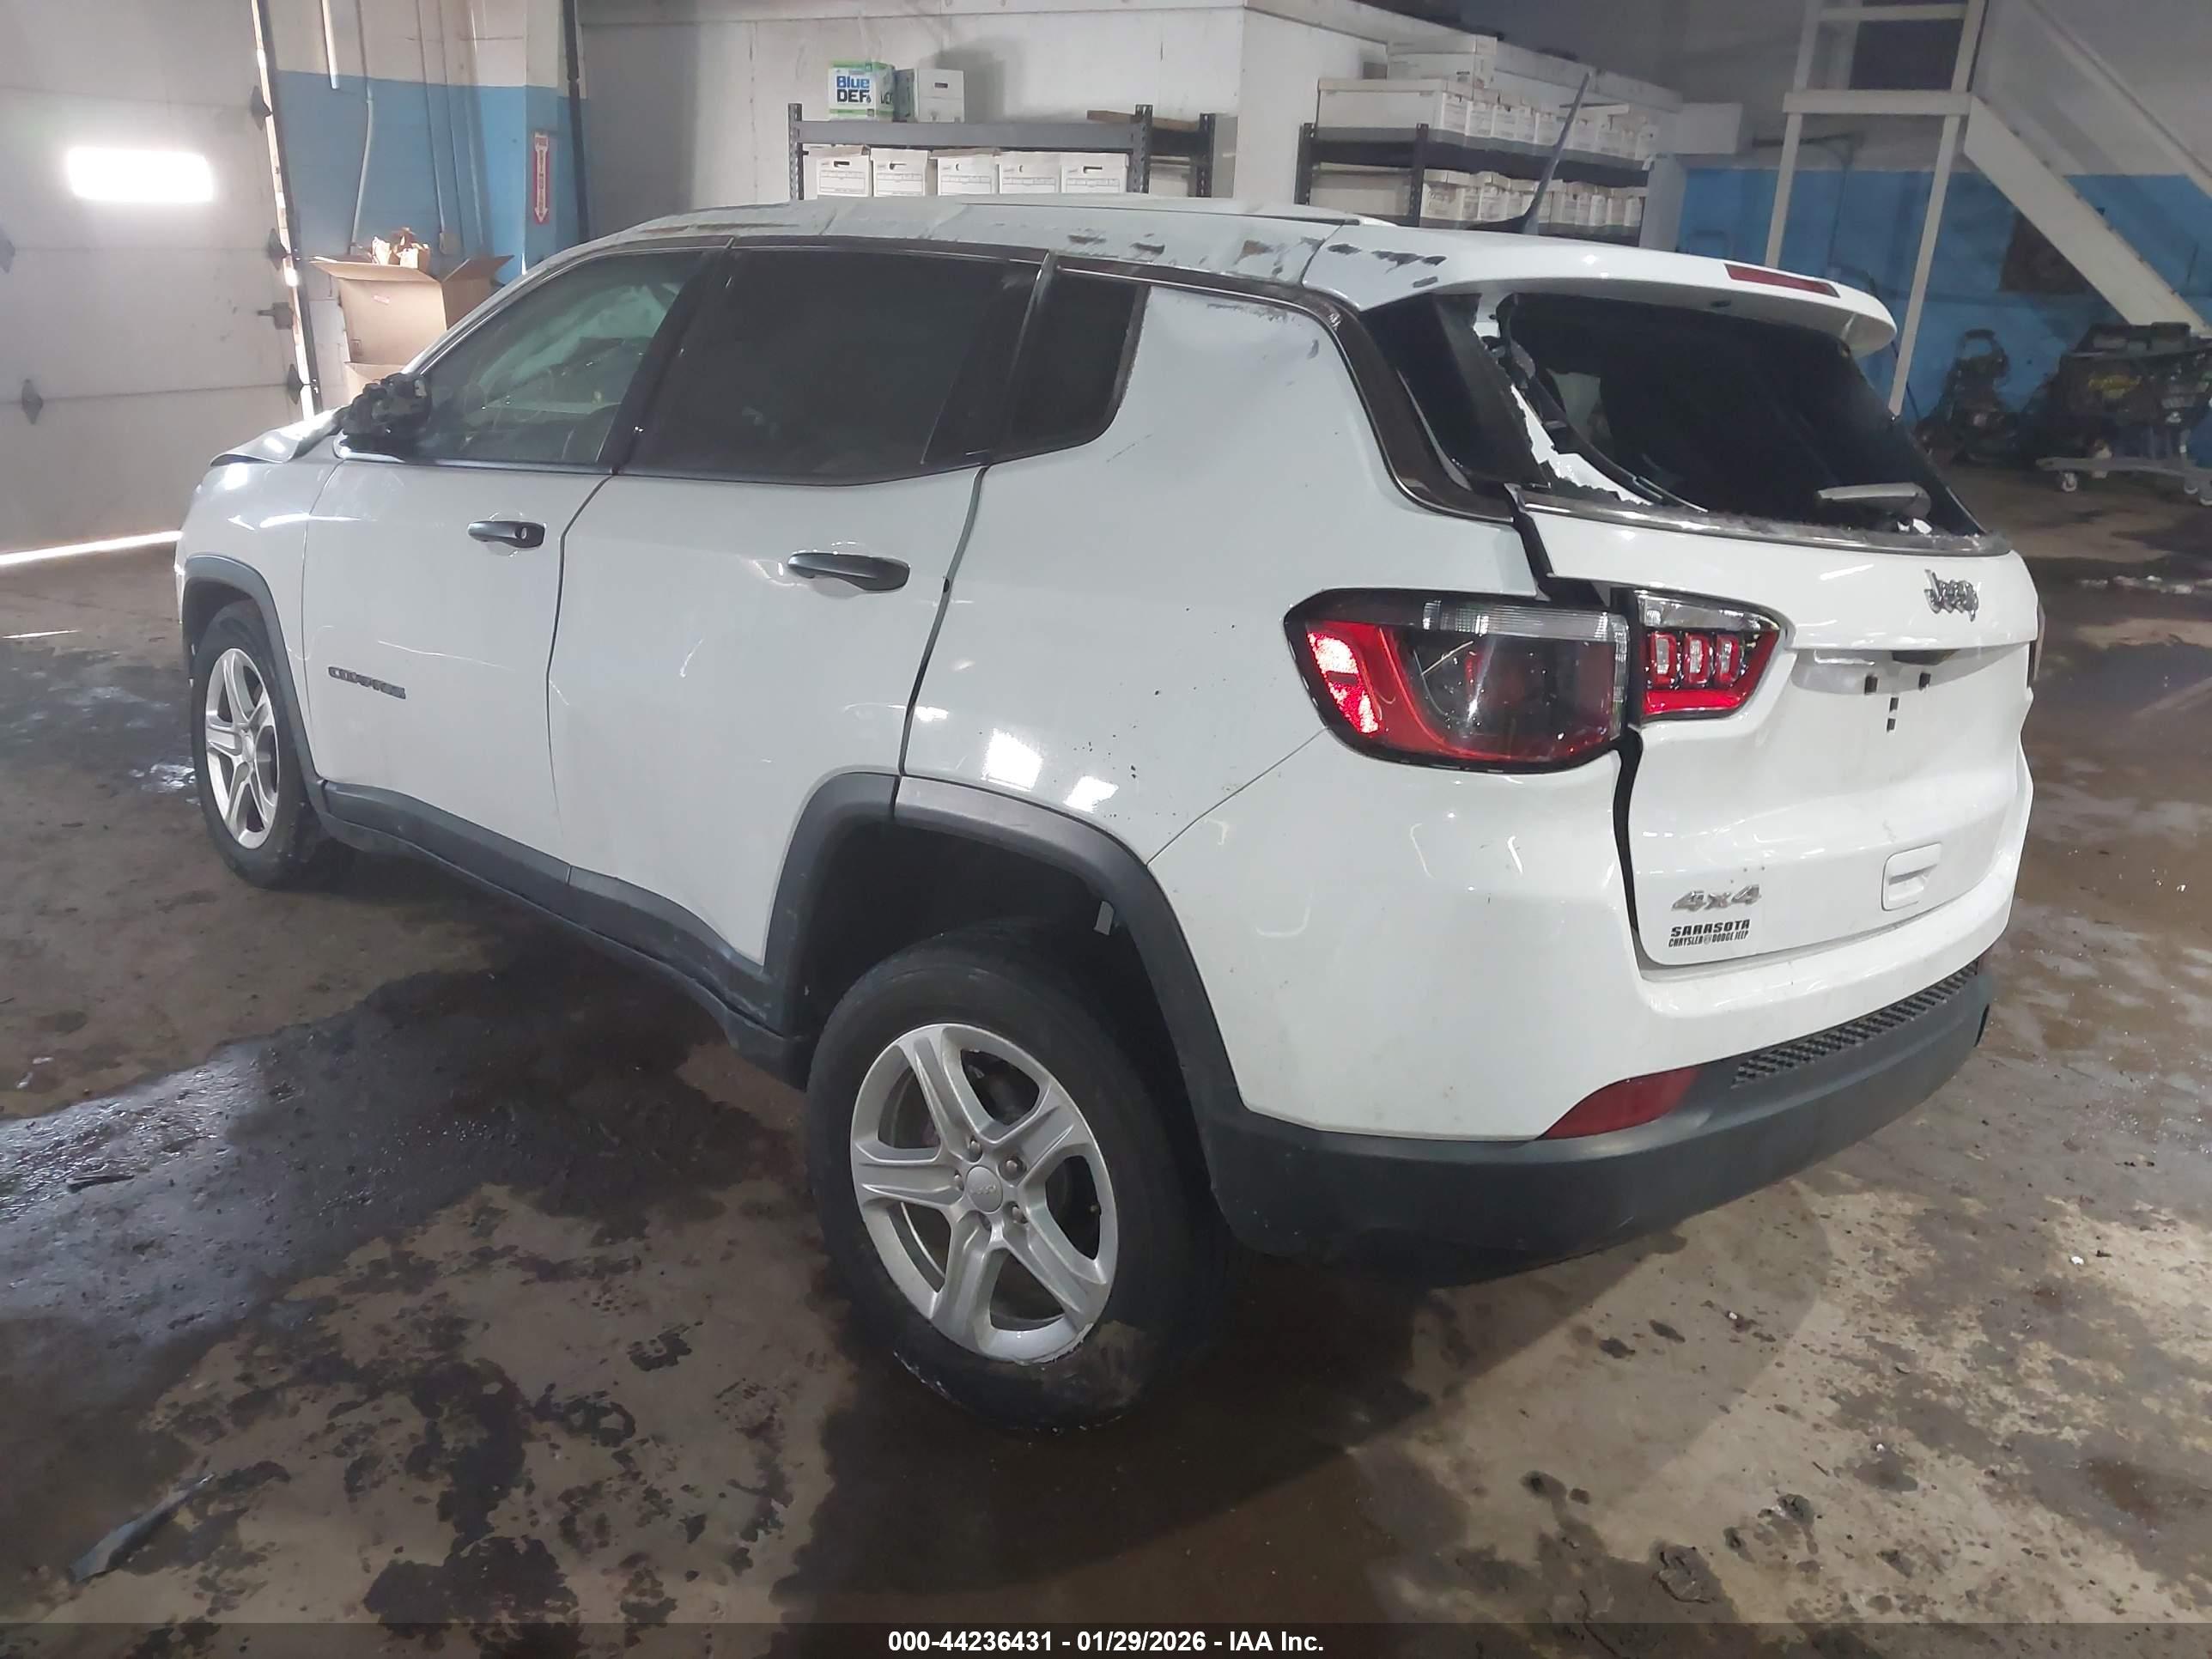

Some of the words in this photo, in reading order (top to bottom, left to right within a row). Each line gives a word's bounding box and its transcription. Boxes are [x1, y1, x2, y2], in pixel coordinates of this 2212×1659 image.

[836, 76, 870, 88] Blue
[836, 89, 870, 102] DEF
[1923, 568, 1979, 622] Jeep
[1670, 919, 1751, 937] SARASOTA
[1668, 935, 1704, 948] CHRYSLER
[1711, 932, 1735, 944] DODGE
[1734, 930, 1749, 940] JEEP
